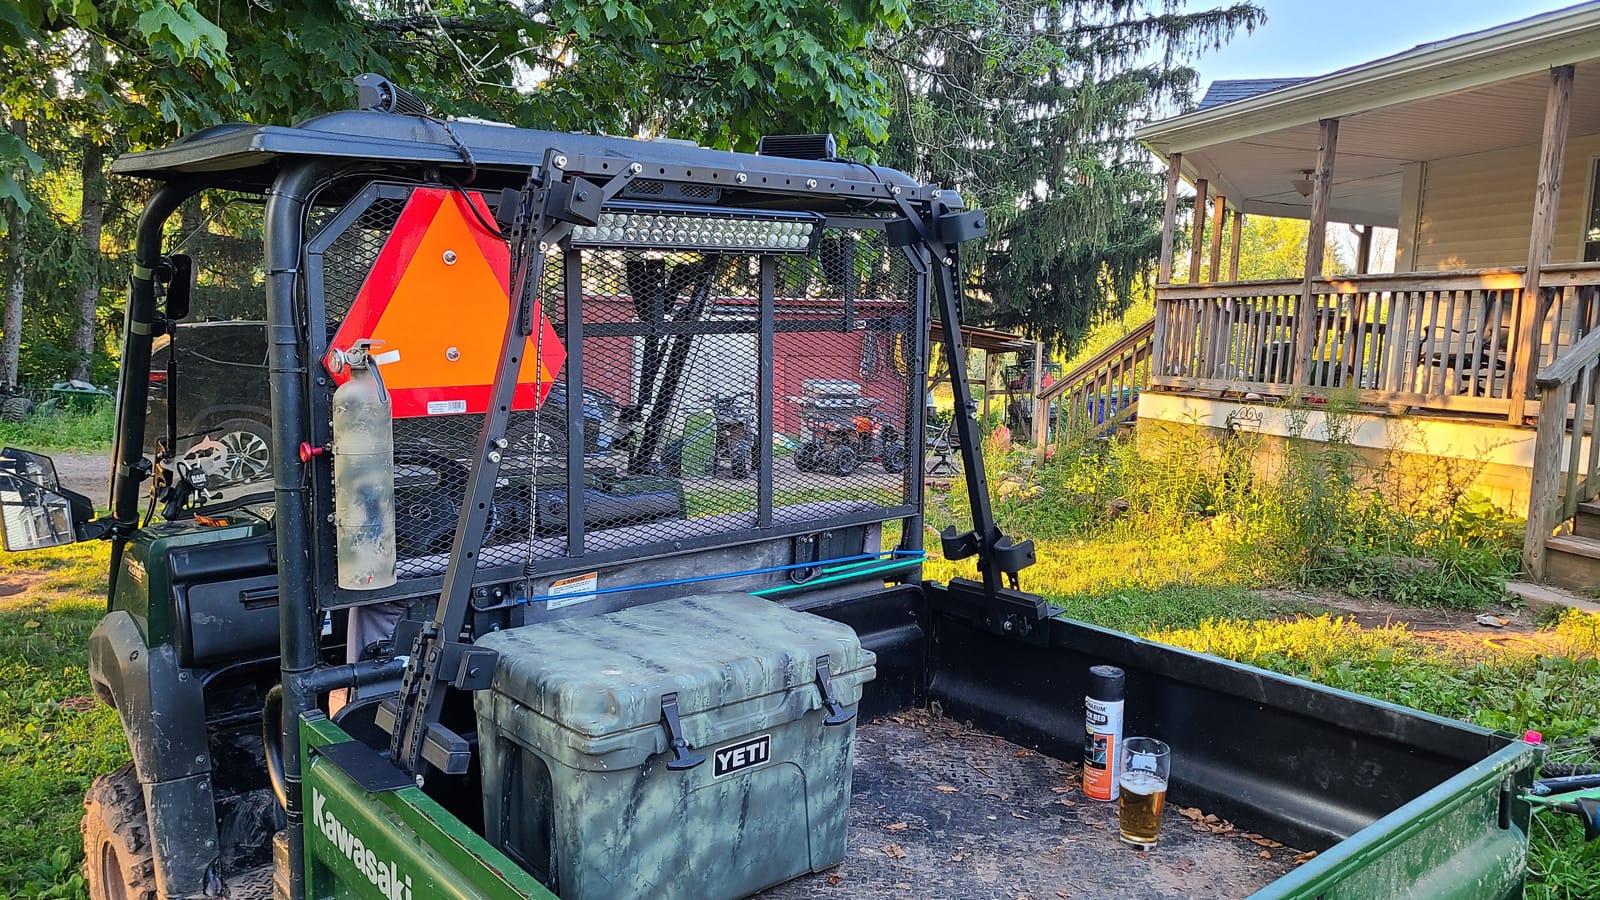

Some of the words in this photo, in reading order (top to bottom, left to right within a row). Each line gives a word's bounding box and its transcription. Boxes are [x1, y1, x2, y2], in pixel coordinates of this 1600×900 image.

[1093, 713, 1106, 722] BED
[716, 741, 766, 771] YETI
[312, 787, 413, 900] Kawasaki
